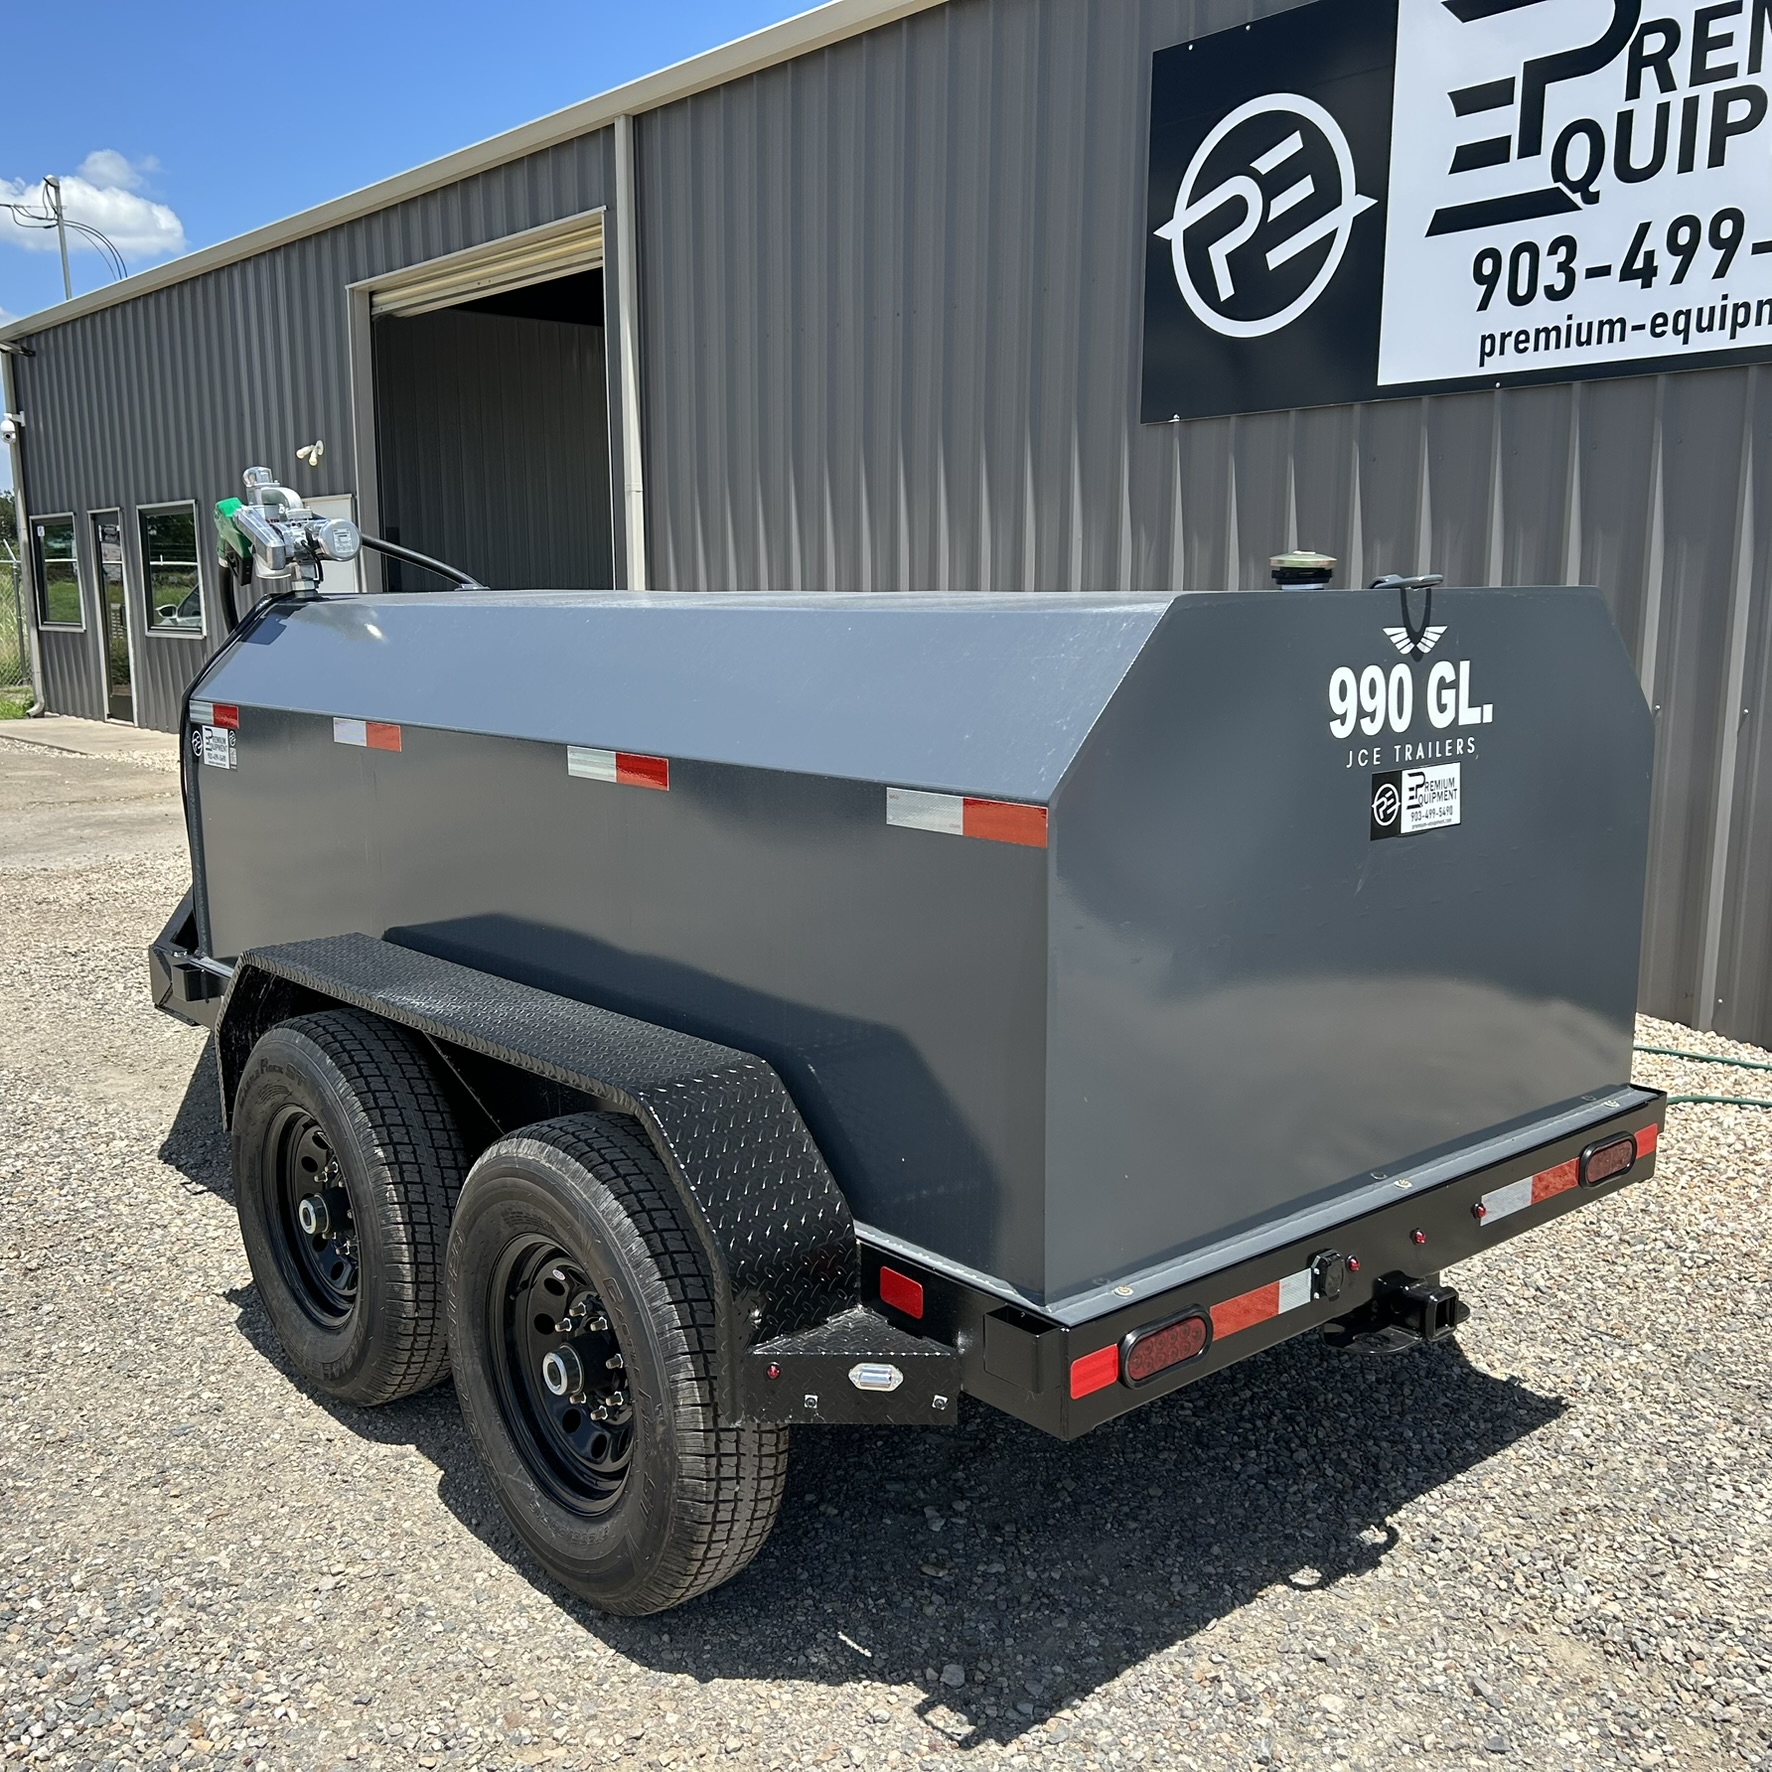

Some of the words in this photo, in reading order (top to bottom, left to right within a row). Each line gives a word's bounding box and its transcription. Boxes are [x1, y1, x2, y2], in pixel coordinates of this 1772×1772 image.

[1329, 663, 1413, 739] 990
[1427, 660, 1493, 729] GL.
[1346, 747, 1381, 769] JCE
[1394, 736, 1476, 763] TRAILERS
[1407, 771, 1455, 799] PREMIUM
[1407, 787, 1457, 810] EQUIPMENT
